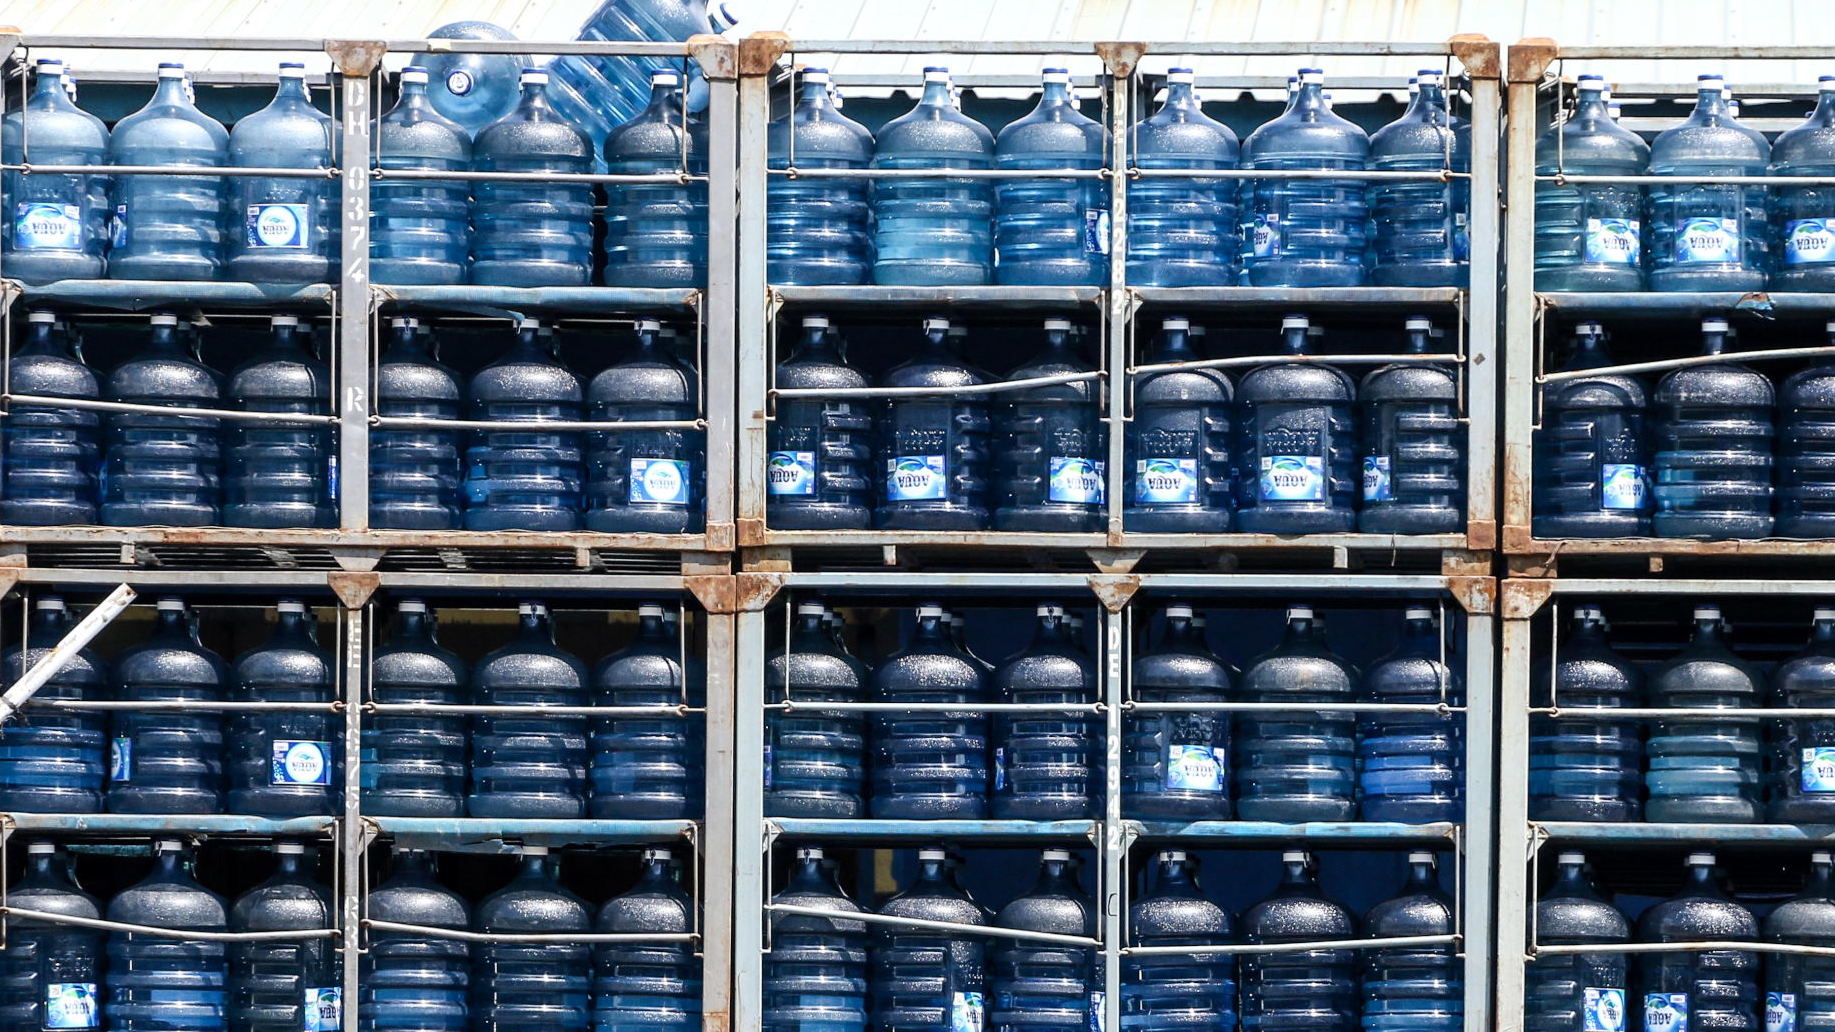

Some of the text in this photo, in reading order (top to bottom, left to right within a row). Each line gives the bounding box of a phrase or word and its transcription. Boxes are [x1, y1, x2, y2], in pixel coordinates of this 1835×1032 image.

[346, 81, 367, 411] DH 0374 R
[1689, 236, 1724, 249] AQUA
[1796, 236, 1828, 250] AQUA
[769, 468, 799, 483] AQUA
[897, 474, 930, 488] AQUA
[1273, 473, 1307, 487] AQUA
[1066, 477, 1096, 490] AQUA
[1148, 476, 1181, 490] AQUA
[1106, 626, 1120, 851] DE 12942
